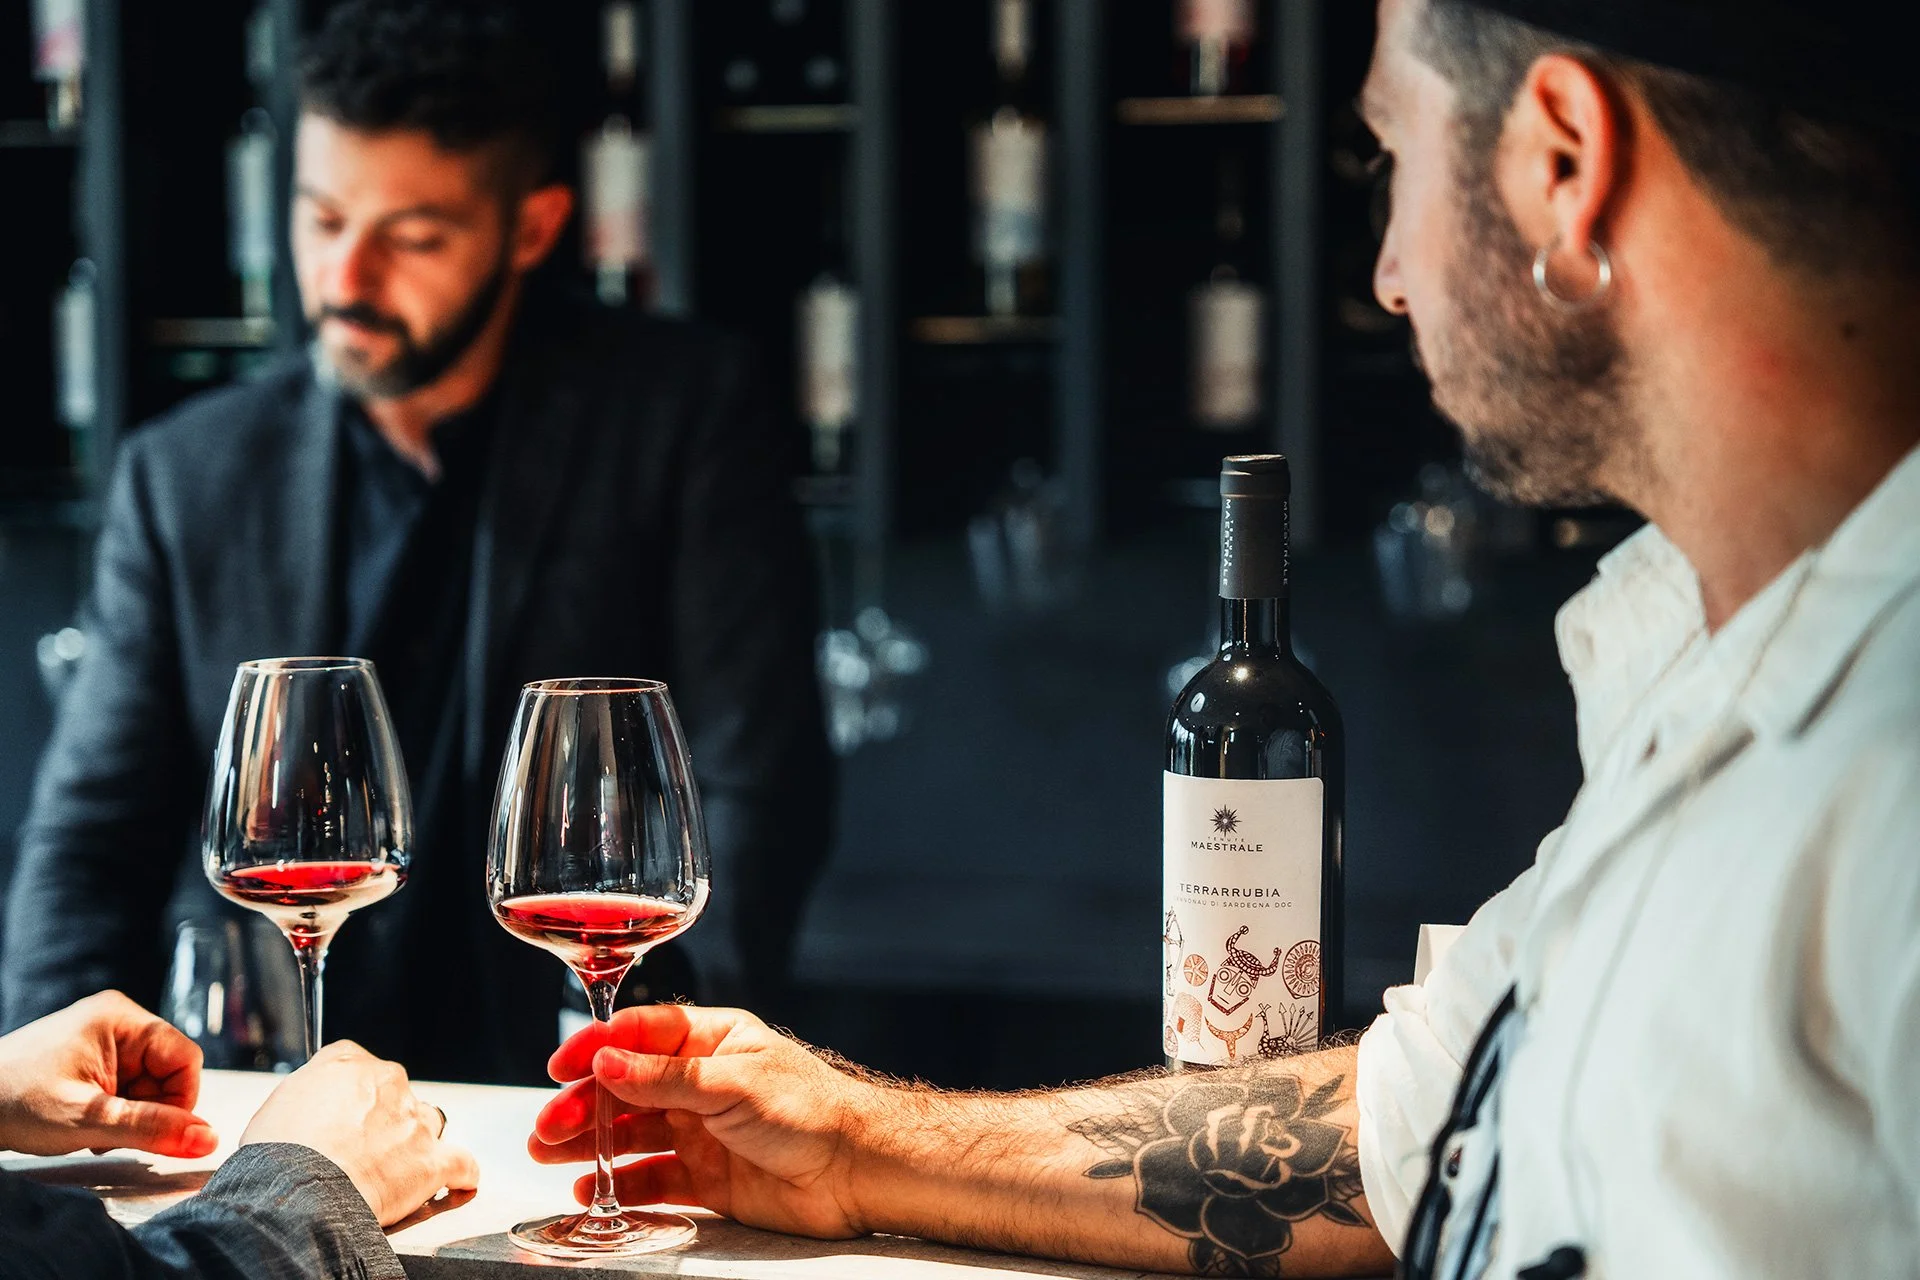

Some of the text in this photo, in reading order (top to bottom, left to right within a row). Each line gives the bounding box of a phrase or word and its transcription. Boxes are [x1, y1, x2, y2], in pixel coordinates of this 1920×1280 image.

[1223, 499, 1231, 586] MAESTRALE
[1190, 841, 1263, 852] MAESTRALE
[1179, 883, 1281, 898] TERRARRUBIA
[1223, 901, 1270, 909] SARDEGNA
